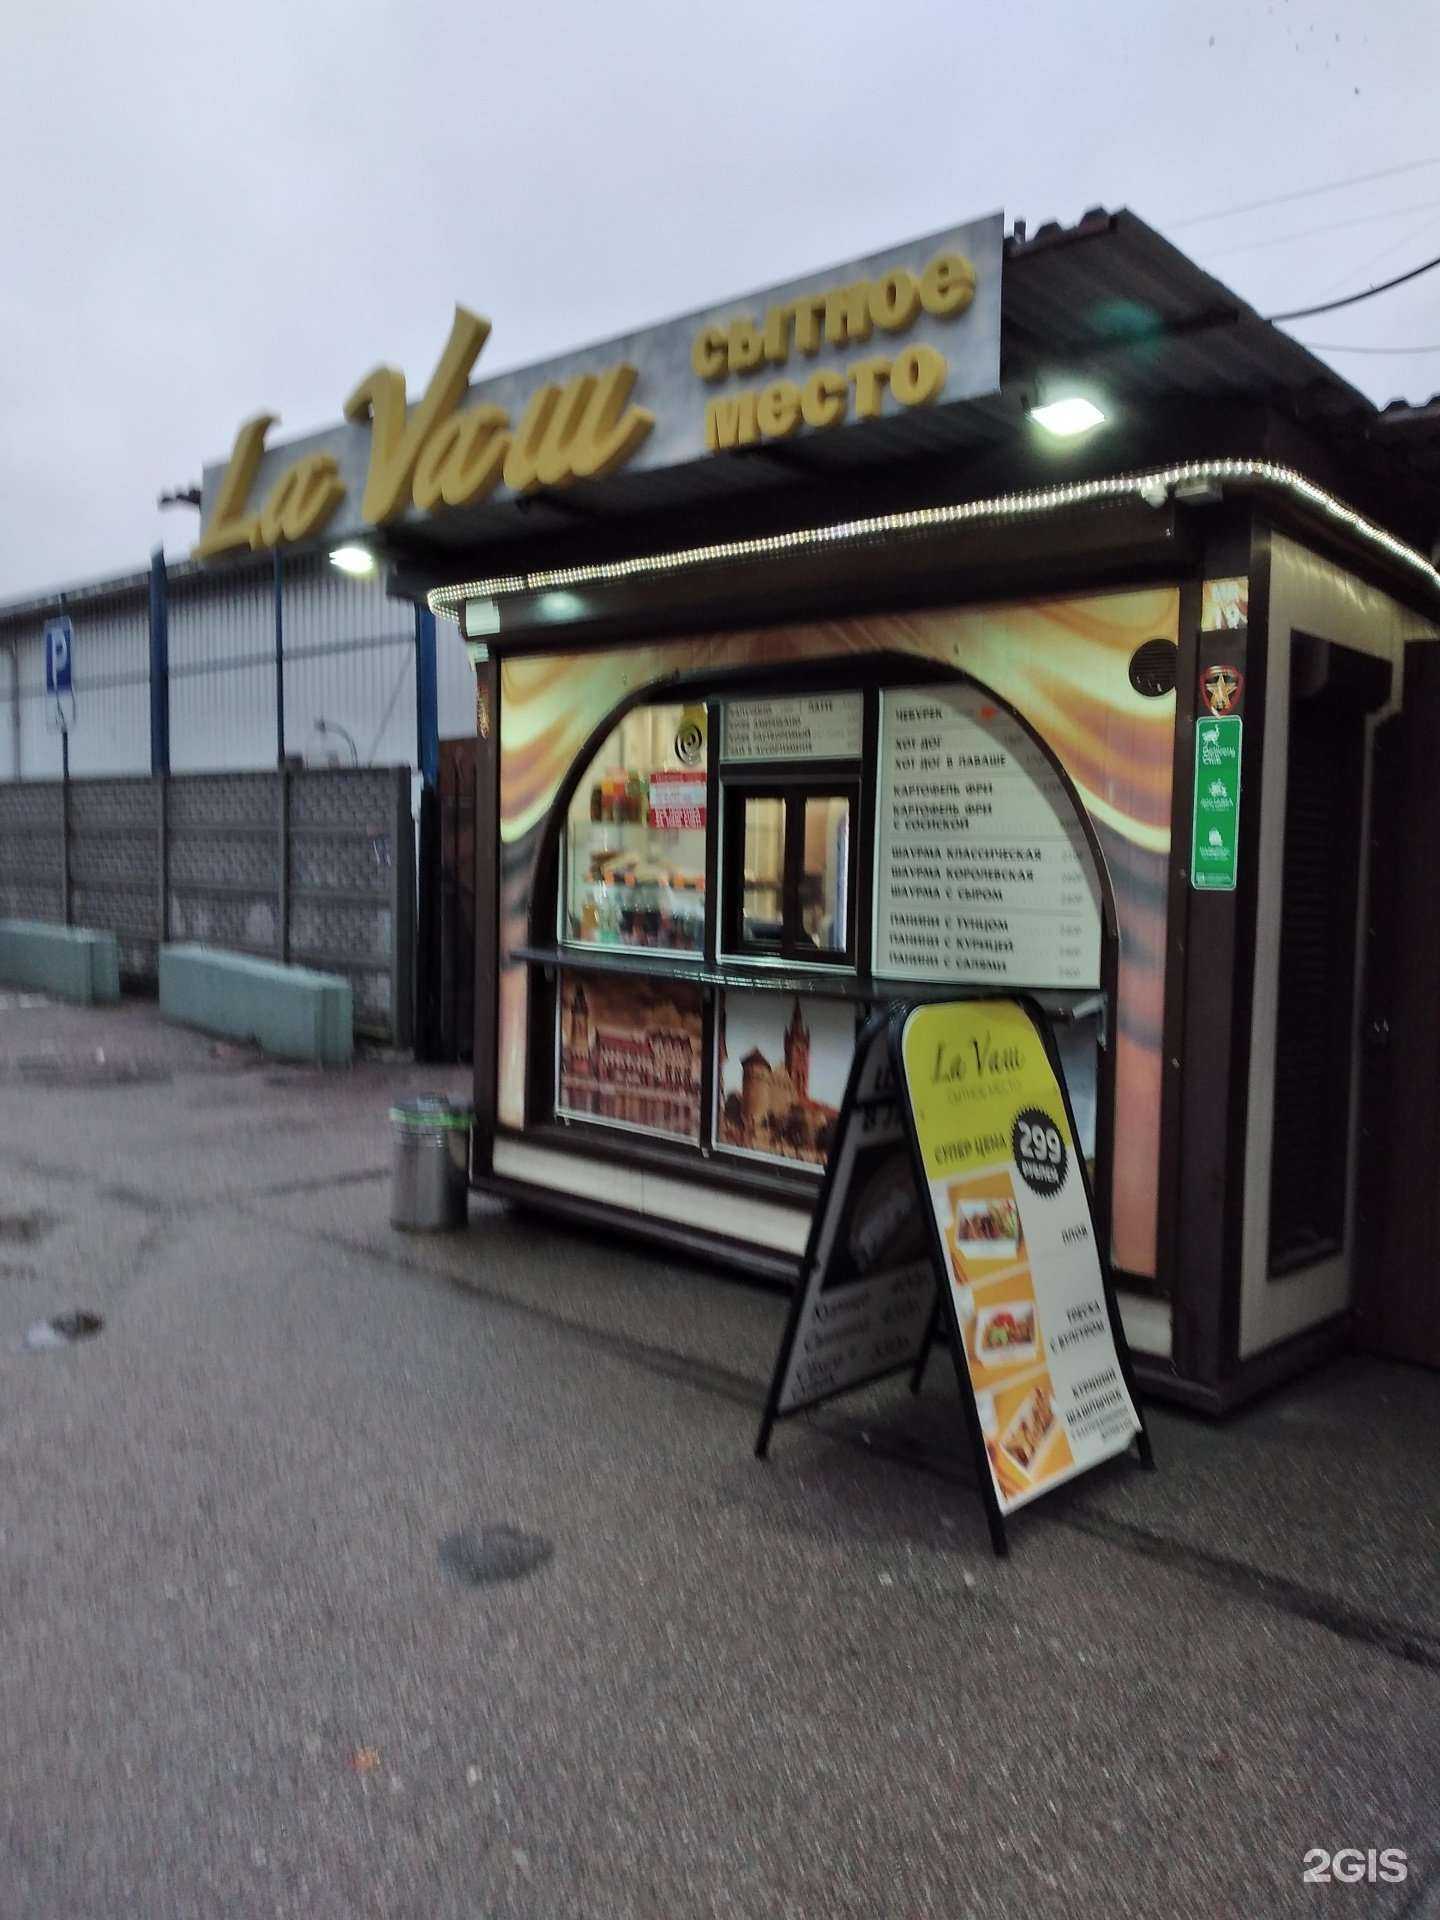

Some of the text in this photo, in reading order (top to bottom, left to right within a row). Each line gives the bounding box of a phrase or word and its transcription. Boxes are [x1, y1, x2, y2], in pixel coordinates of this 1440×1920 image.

[959, 754, 1007, 768] ЛАВАШЕ
[891, 847, 941, 860] ШАУРМА
[891, 866, 940, 879] ШАУРМА
[891, 886, 940, 899] ШАУРМА
[1019, 1121, 1062, 1164] 299
